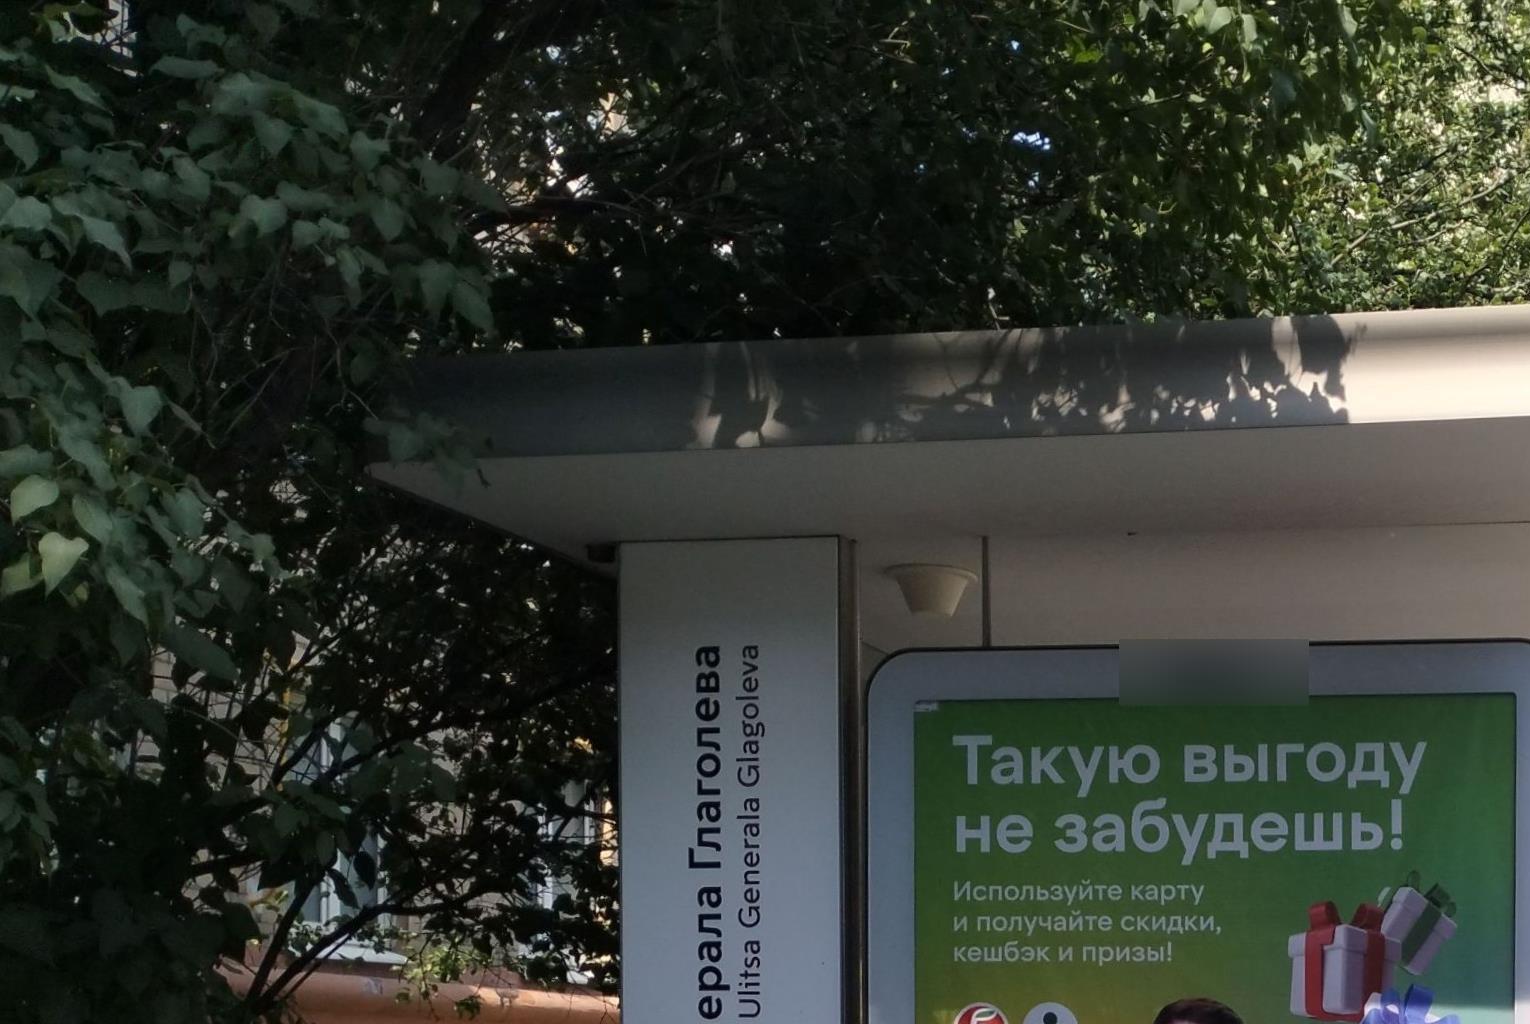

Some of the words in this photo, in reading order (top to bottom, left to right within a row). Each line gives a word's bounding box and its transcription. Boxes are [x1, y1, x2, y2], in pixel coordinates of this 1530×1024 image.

[736, 644, 765, 788] Glagoleva
[688, 644, 722, 870] Глаголева
[952, 734, 1160, 796] Такую
[1183, 740, 1427, 794] выгоду
[738, 795, 761, 928] Generala
[955, 813, 1032, 853] не
[1054, 798, 1405, 864] забудешь!
[952, 880, 1123, 906] Используйте
[1131, 883, 1205, 907] карту
[953, 913, 968, 931] и
[975, 910, 1113, 936] получайте
[1120, 913, 1222, 935] скидки,
[738, 938, 761, 1019] Ulitsa
[952, 941, 1050, 962] кешбэк
[1059, 945, 1073, 961] и
[1082, 942, 1173, 966] призы!
